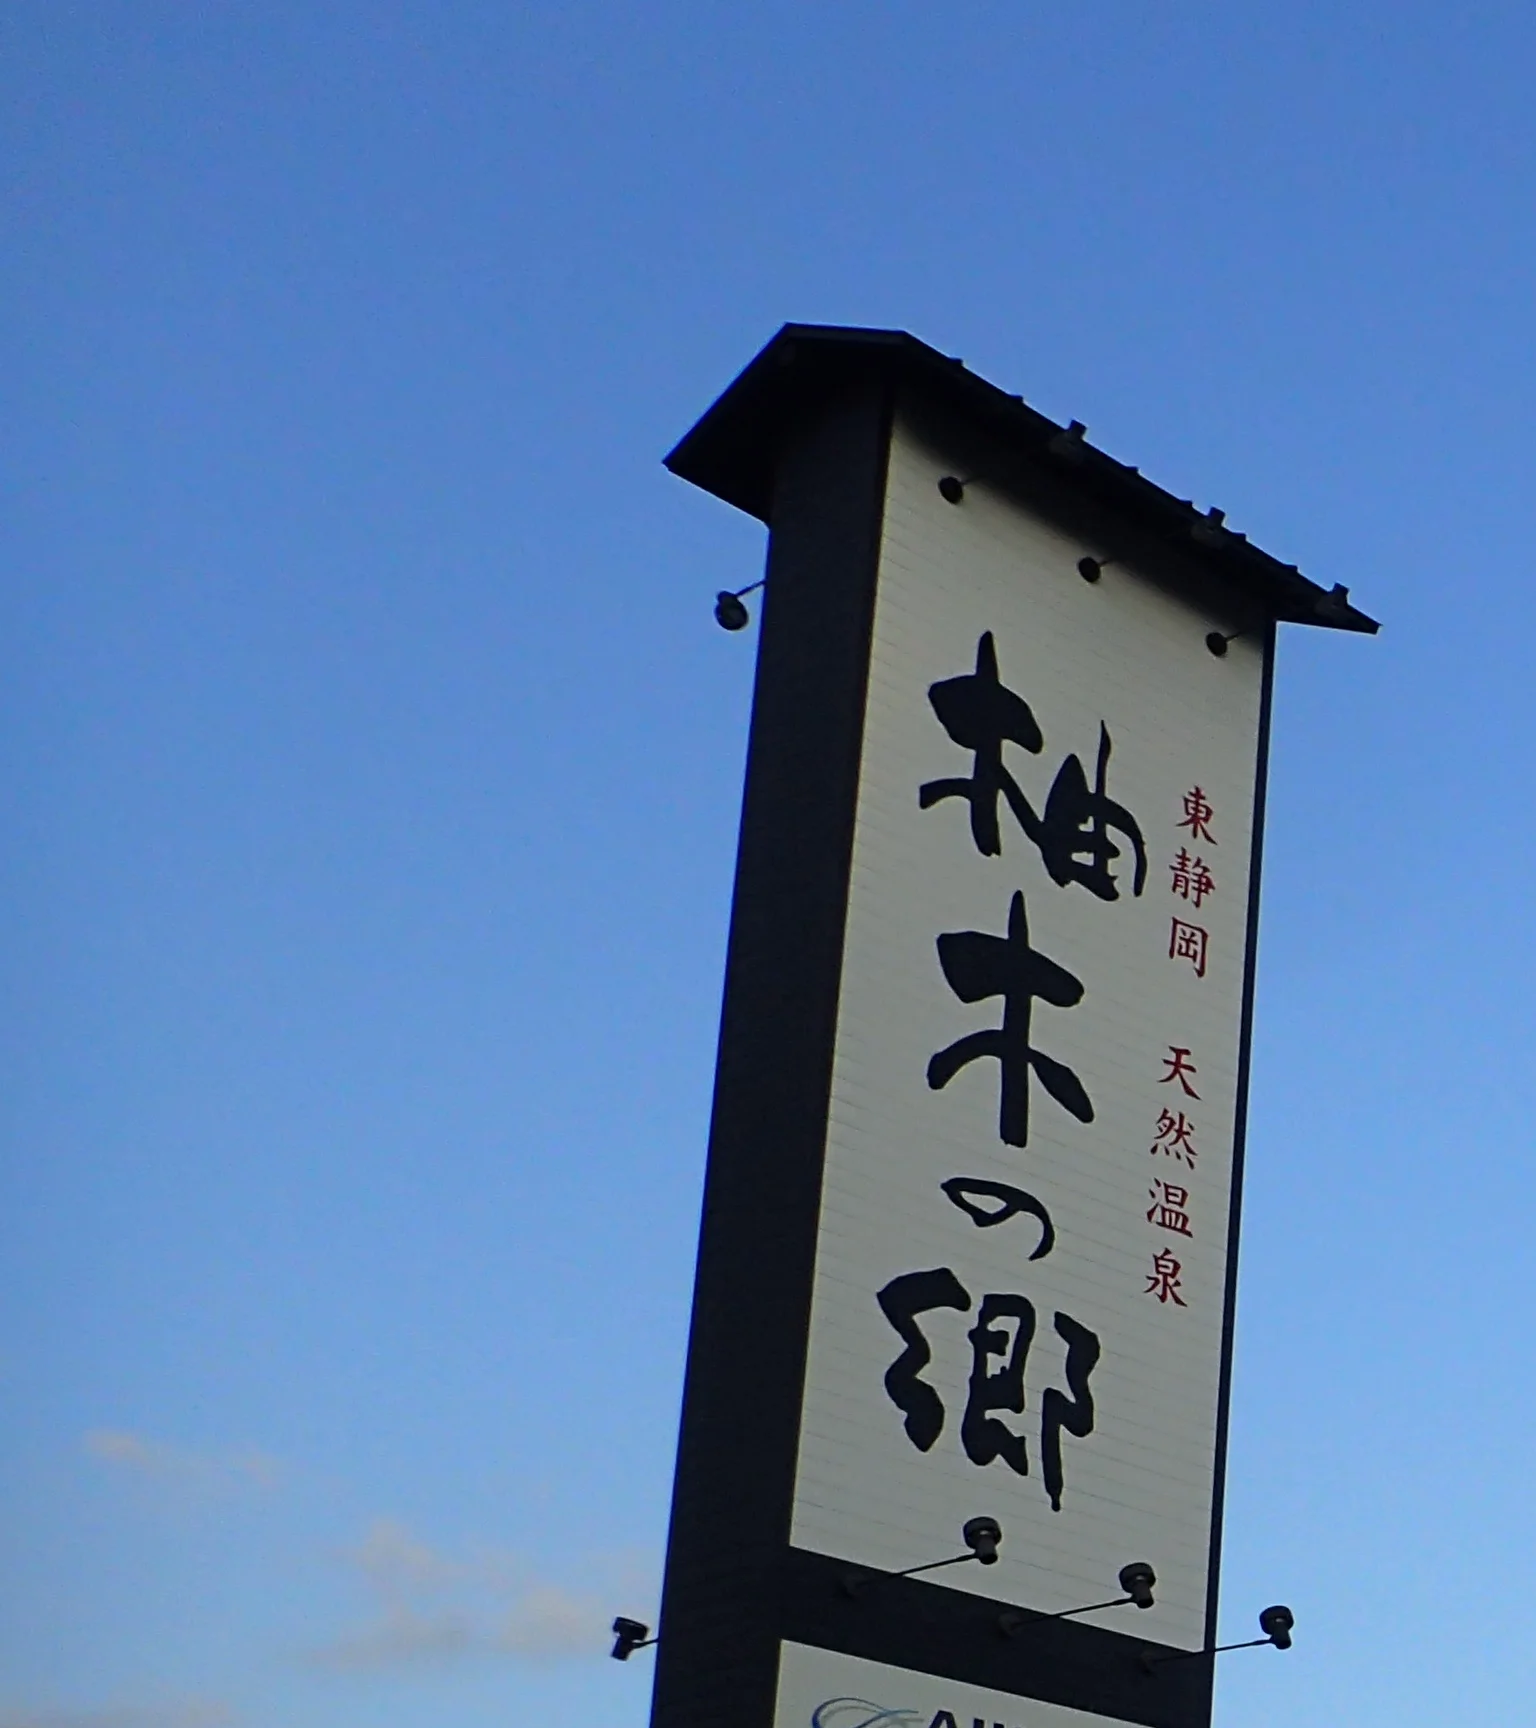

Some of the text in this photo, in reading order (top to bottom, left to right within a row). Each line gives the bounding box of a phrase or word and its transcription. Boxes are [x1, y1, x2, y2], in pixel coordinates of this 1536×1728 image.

[877, 631, 1147, 1511] 柚木の郷
[1144, 786, 1218, 1308] 東静岡 天然温泉
